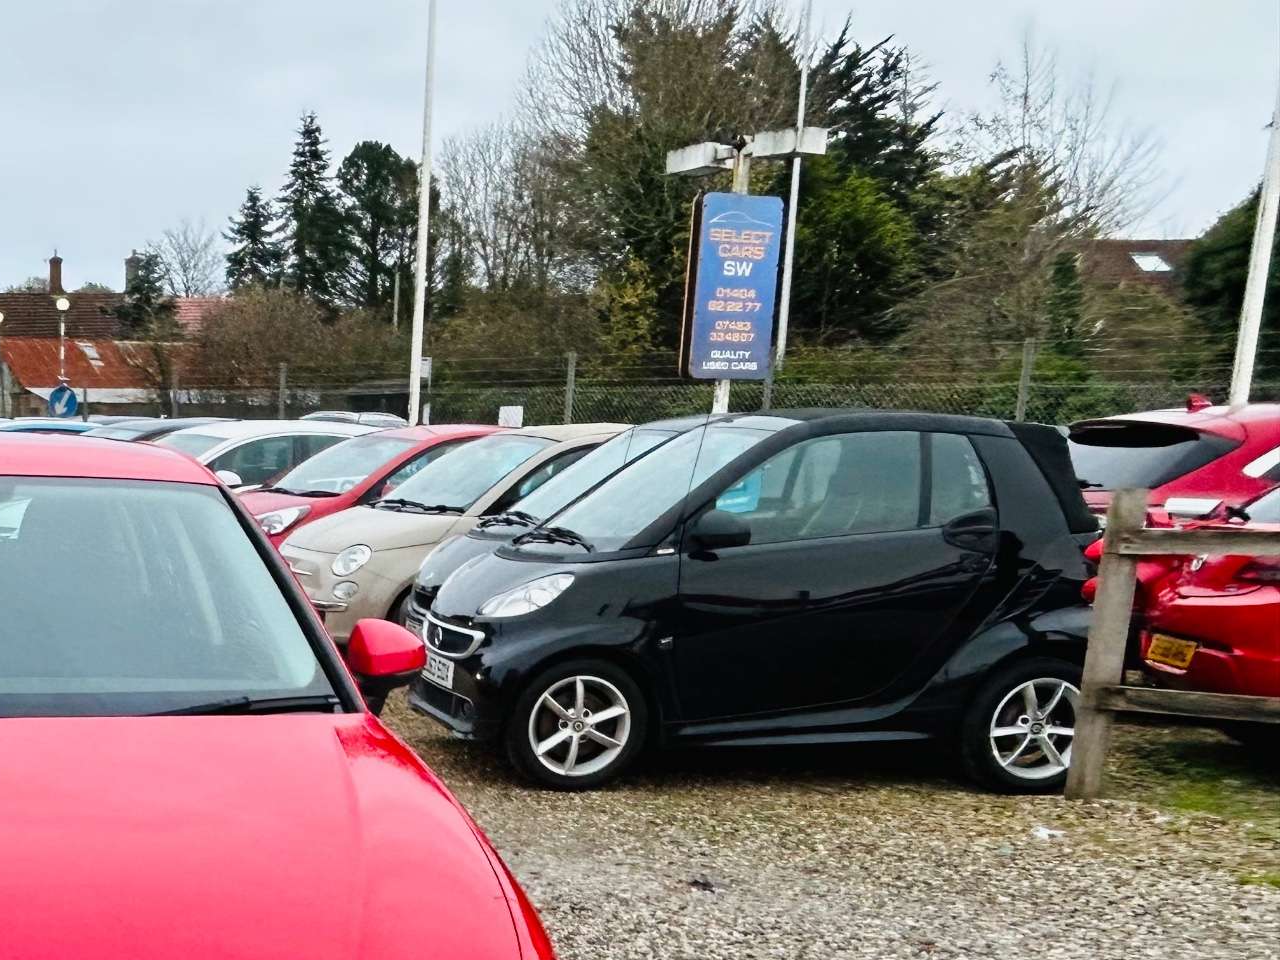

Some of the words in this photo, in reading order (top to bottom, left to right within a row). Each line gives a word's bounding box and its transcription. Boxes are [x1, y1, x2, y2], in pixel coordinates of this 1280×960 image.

[709, 228, 774, 244] SELECT
[718, 243, 766, 260] CARS
[723, 260, 753, 277] SW
[710, 350, 751, 359] QUALITY
[702, 361, 729, 370] USED
[731, 361, 758, 371] CARS
